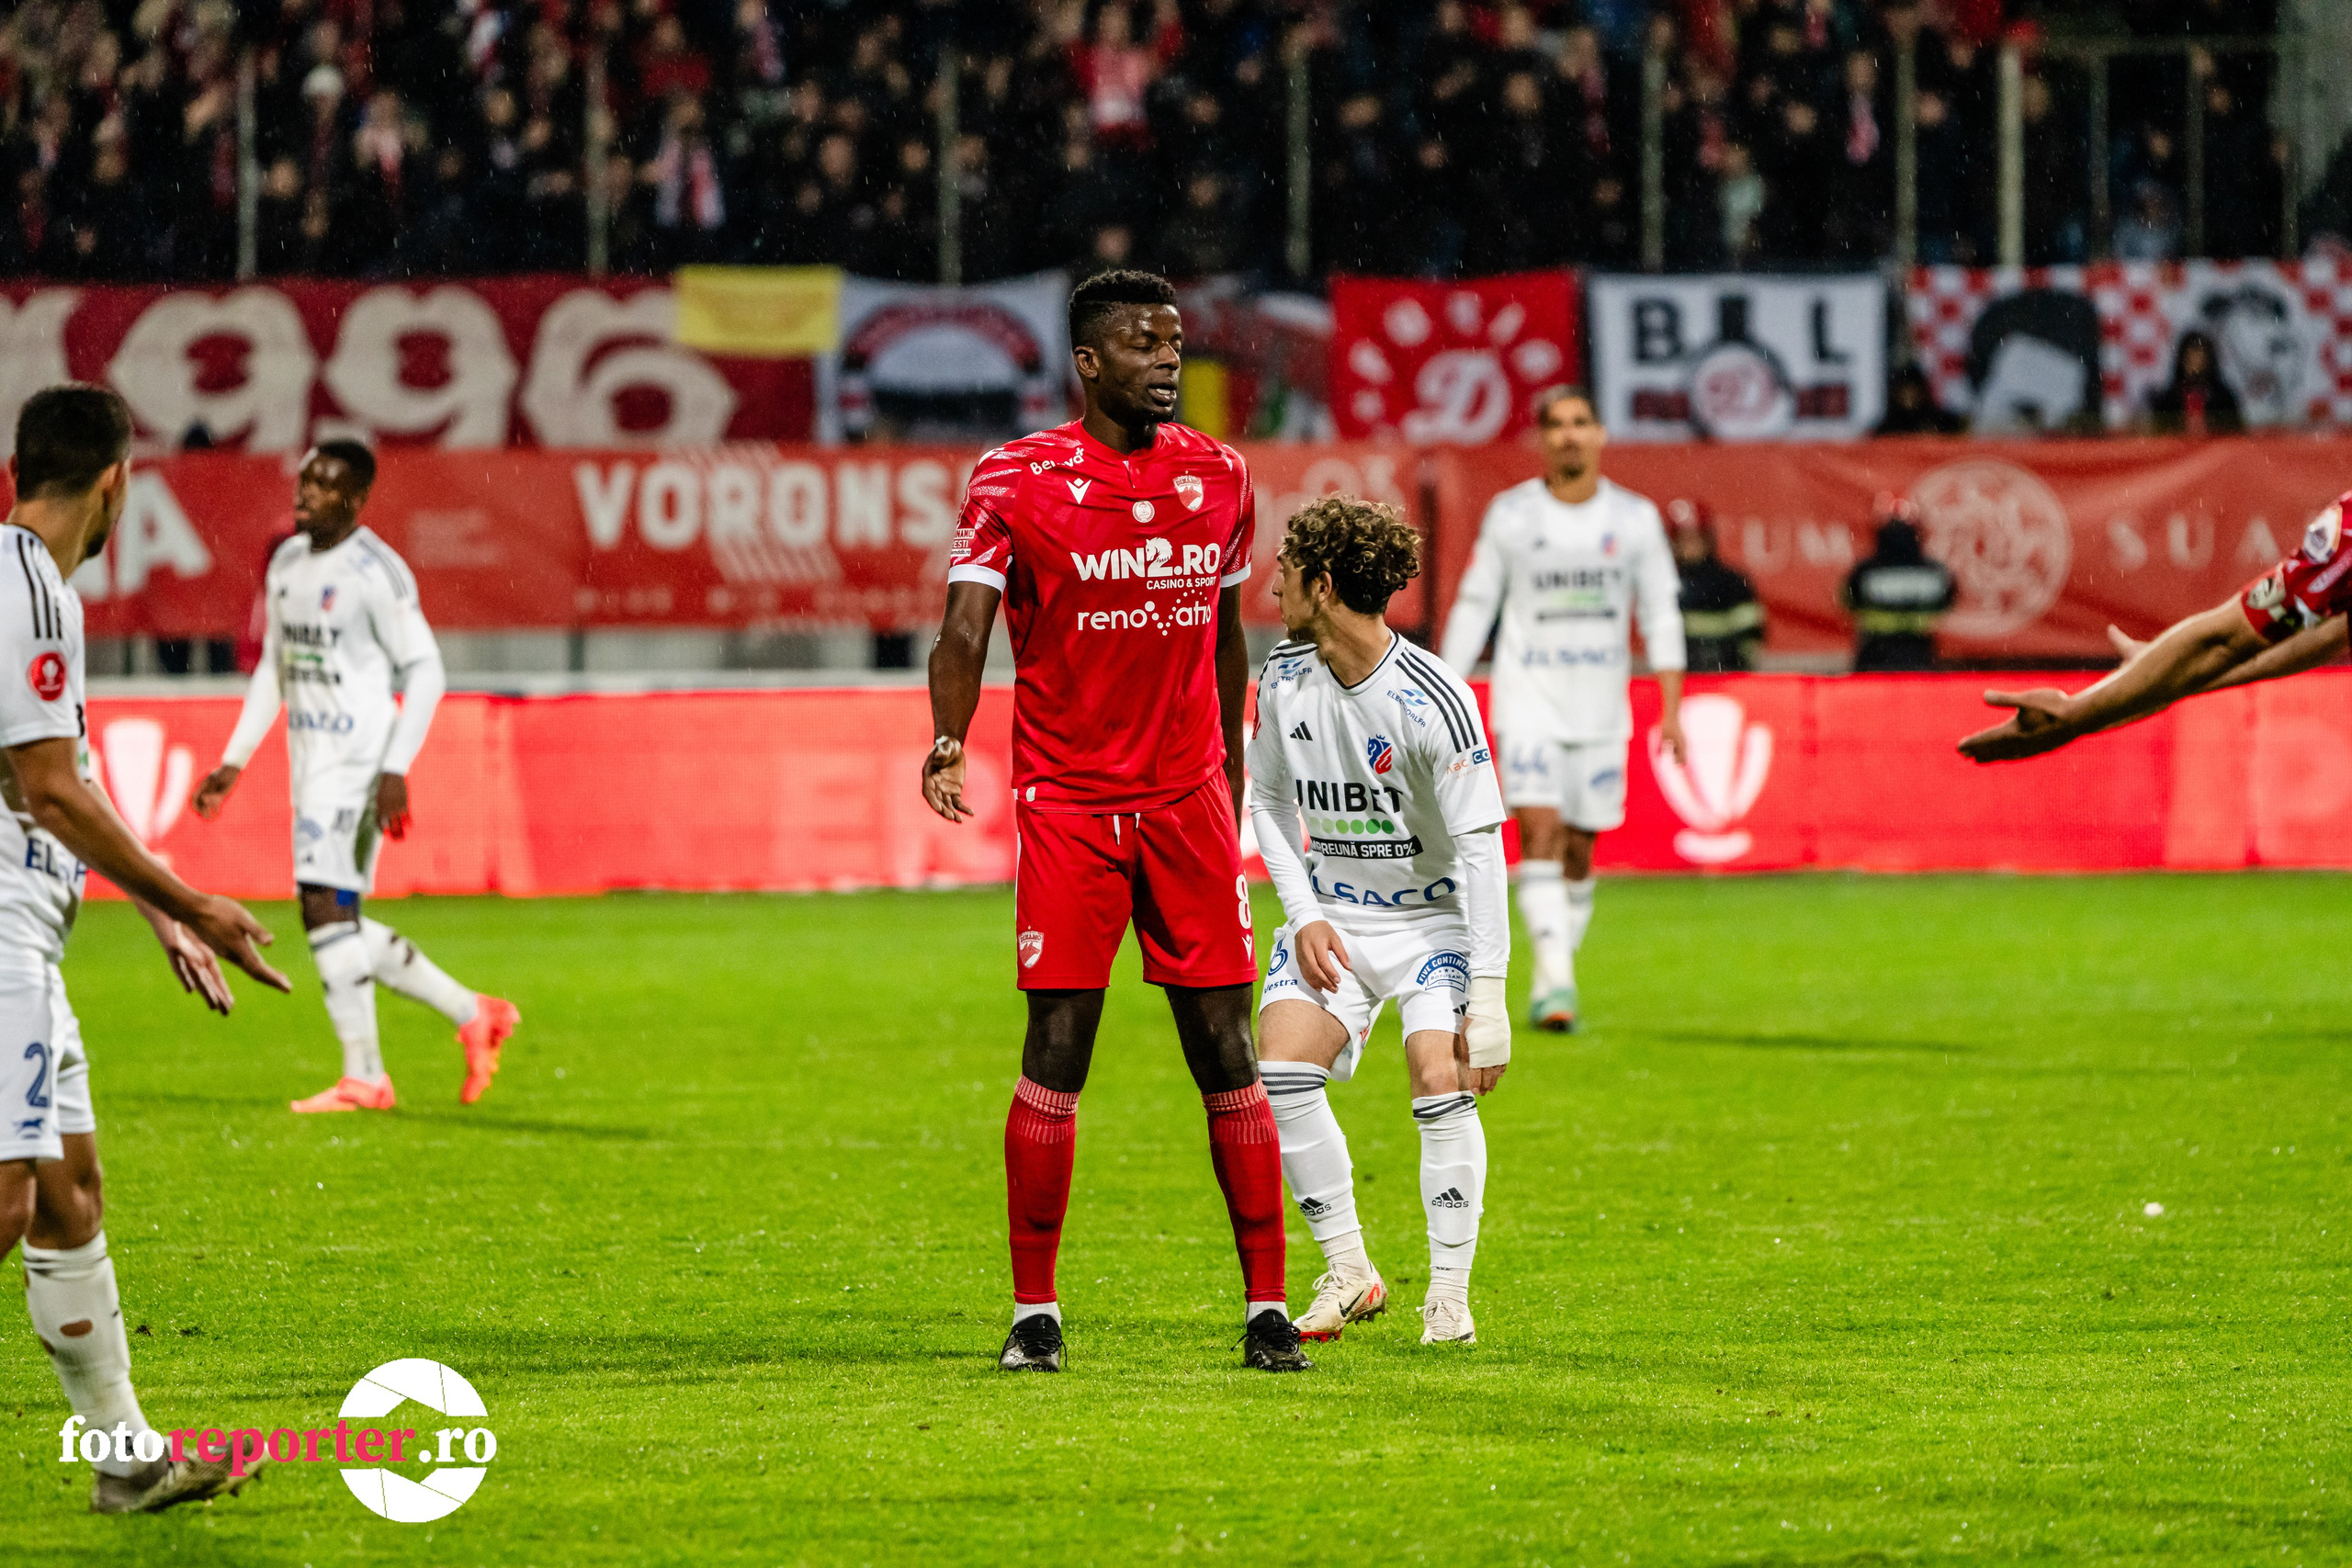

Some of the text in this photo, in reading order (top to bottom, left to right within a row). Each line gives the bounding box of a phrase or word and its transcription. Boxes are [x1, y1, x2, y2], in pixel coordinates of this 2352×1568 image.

[574, 462, 978, 551] VORONS
[956, 528, 975, 539] NAMO
[952, 540, 969, 548] ESTI
[1146, 576, 1217, 591] CASINO & SPORT
[1311, 840, 1416, 858] MPREUNĂ SPRE 0%
[1308, 863, 1456, 907] LSACO
[1236, 874, 1251, 929] 8
[1419, 956, 1471, 982] FIVE CONTINEN
[1300, 1203, 1332, 1217] didas
[1431, 1198, 1469, 1209] adidas
